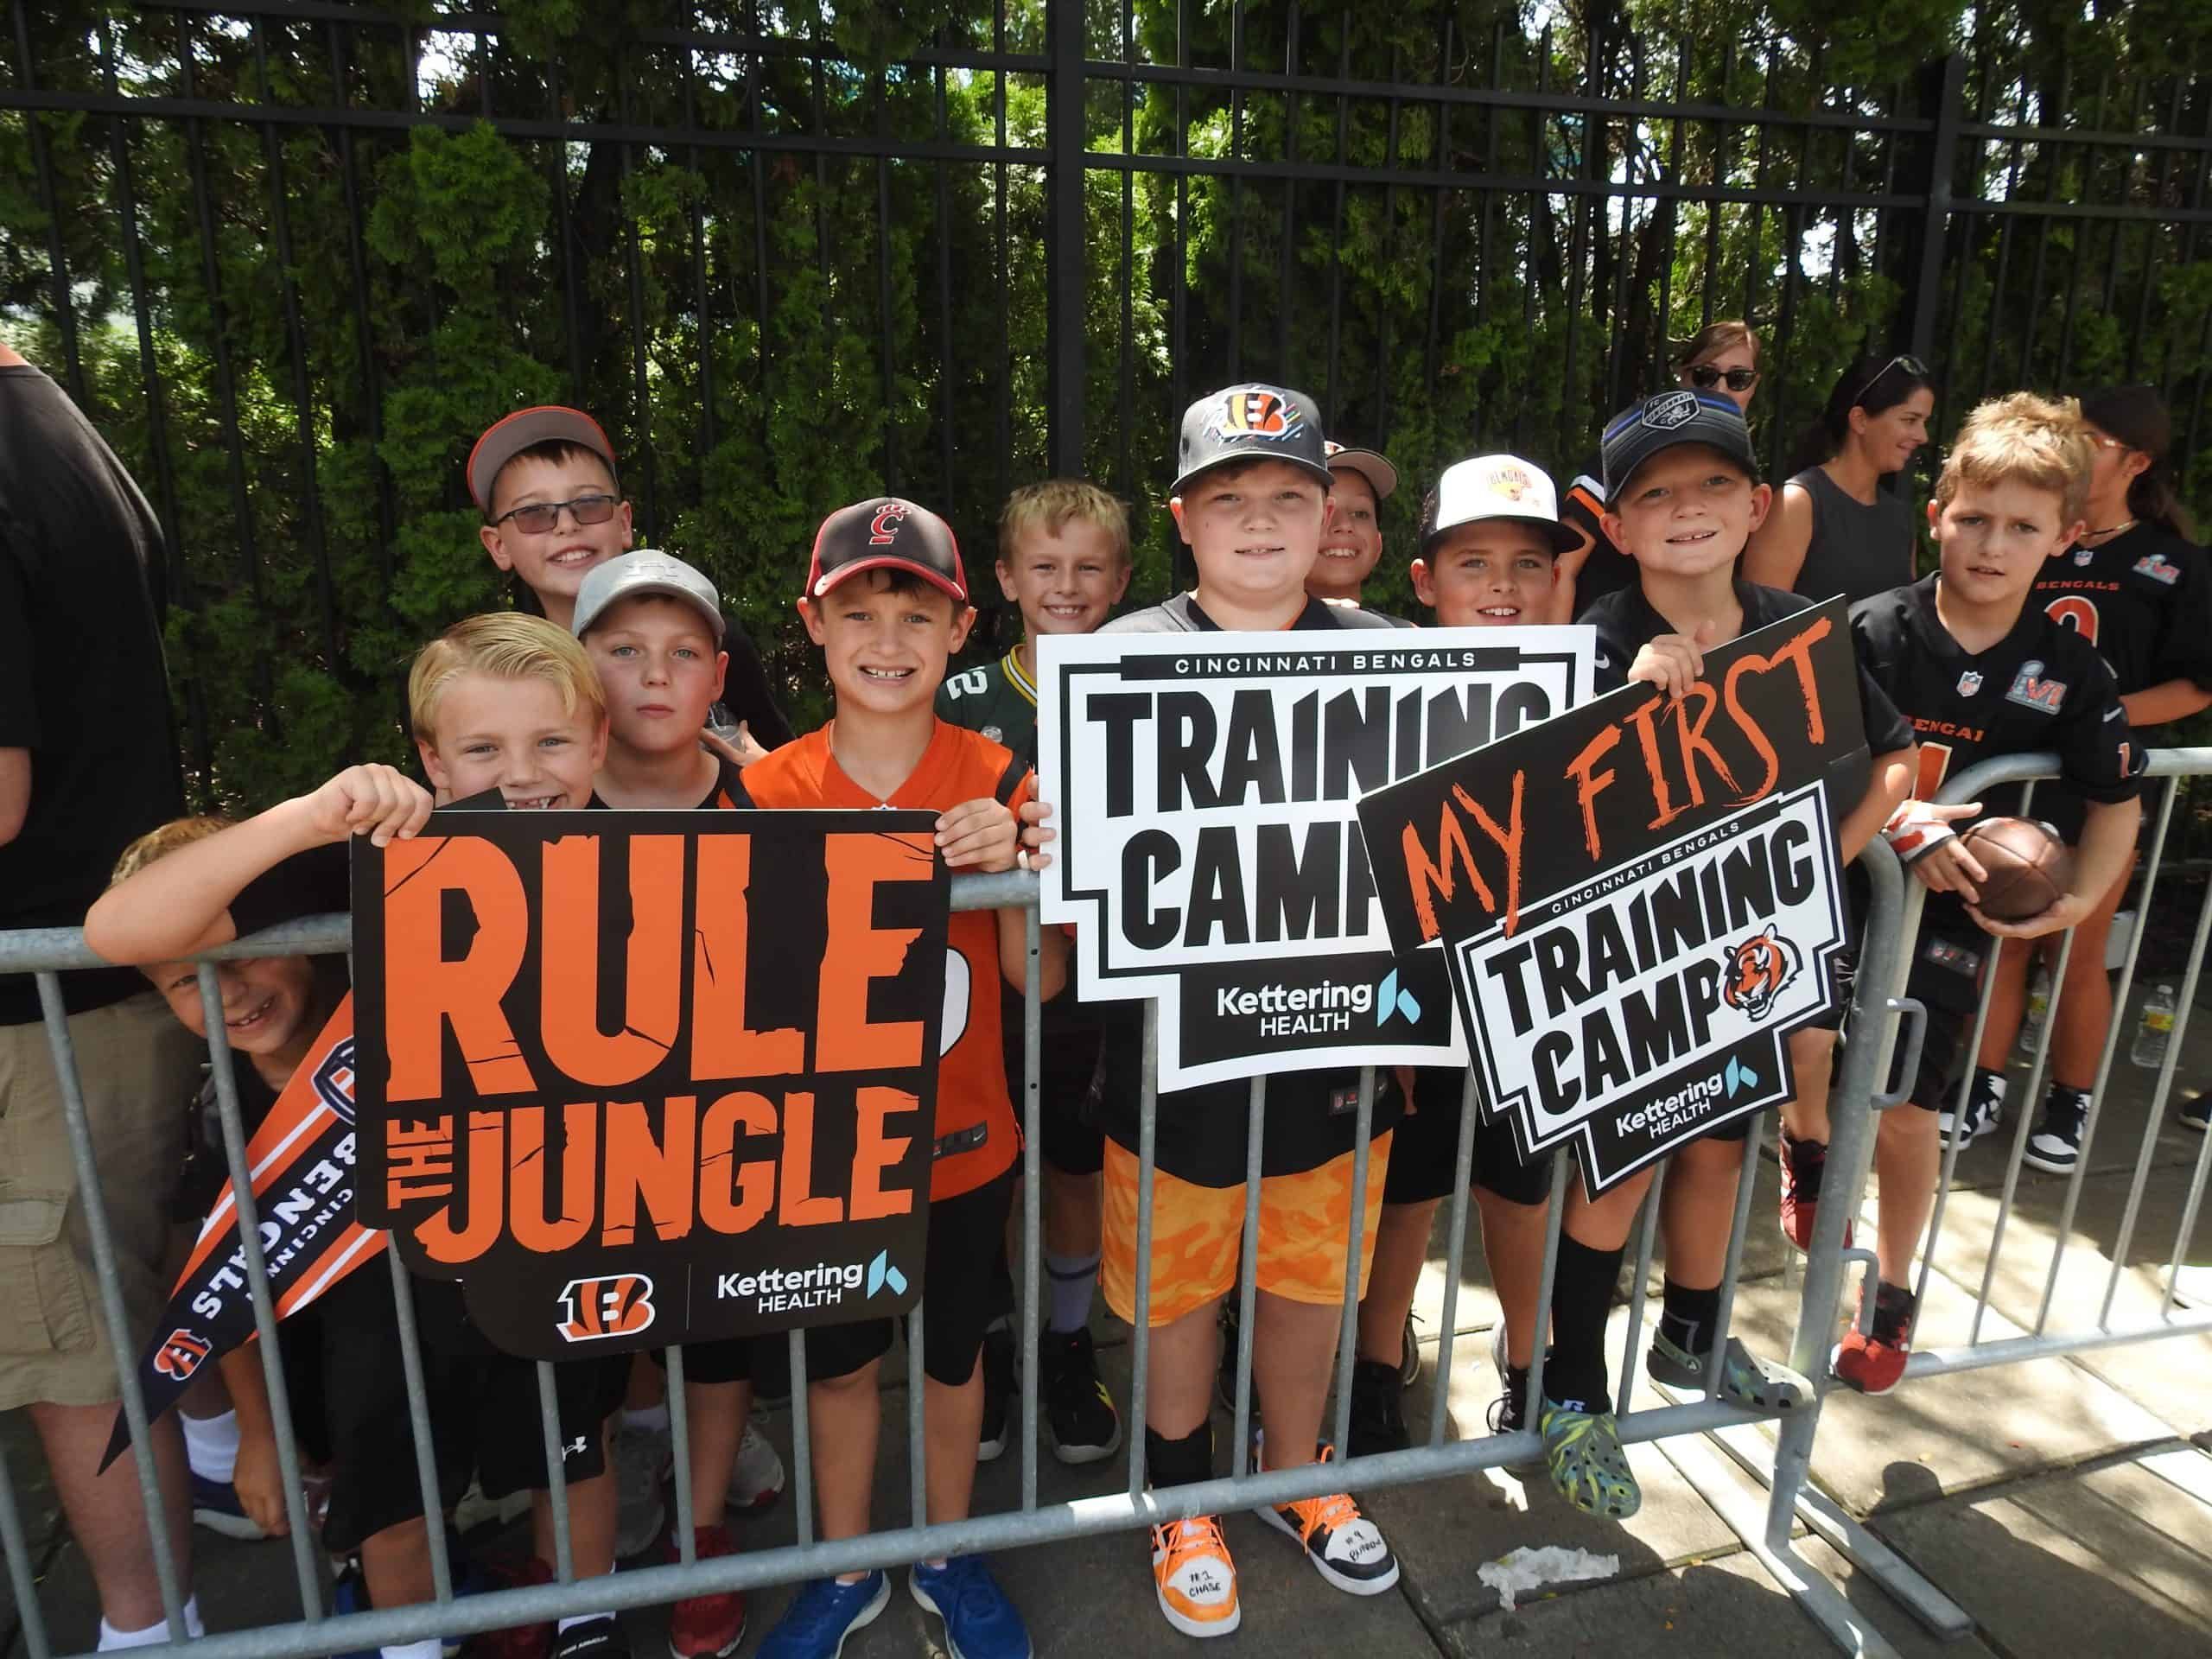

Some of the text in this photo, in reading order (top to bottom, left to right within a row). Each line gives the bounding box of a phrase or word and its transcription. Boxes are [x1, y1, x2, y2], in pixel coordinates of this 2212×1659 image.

[2034, 580, 2120, 591] BENGALS
[1175, 652, 1476, 674] CINCINNATI BENGALS
[1402, 617, 1833, 942] MY FIRST
[1551, 822, 1740, 914] CINCINNATI BENGALS
[1484, 819, 1815, 1037] TRAINING
[384, 833, 936, 1102] RULE
[1217, 980, 1372, 1017] Kettering
[1261, 1011, 1350, 1037] HEALTH
[1531, 958, 1721, 1116] CAMP
[1616, 1072, 1723, 1138] Kettering
[1649, 1096, 1711, 1139] HEALTH
[386, 1115, 453, 1209] THE
[414, 1086, 920, 1263] JUNGLE
[717, 1262, 863, 1300] Kettering
[758, 1287, 842, 1314] HEALTH
[1189, 1582, 1222, 1598] CHASE
